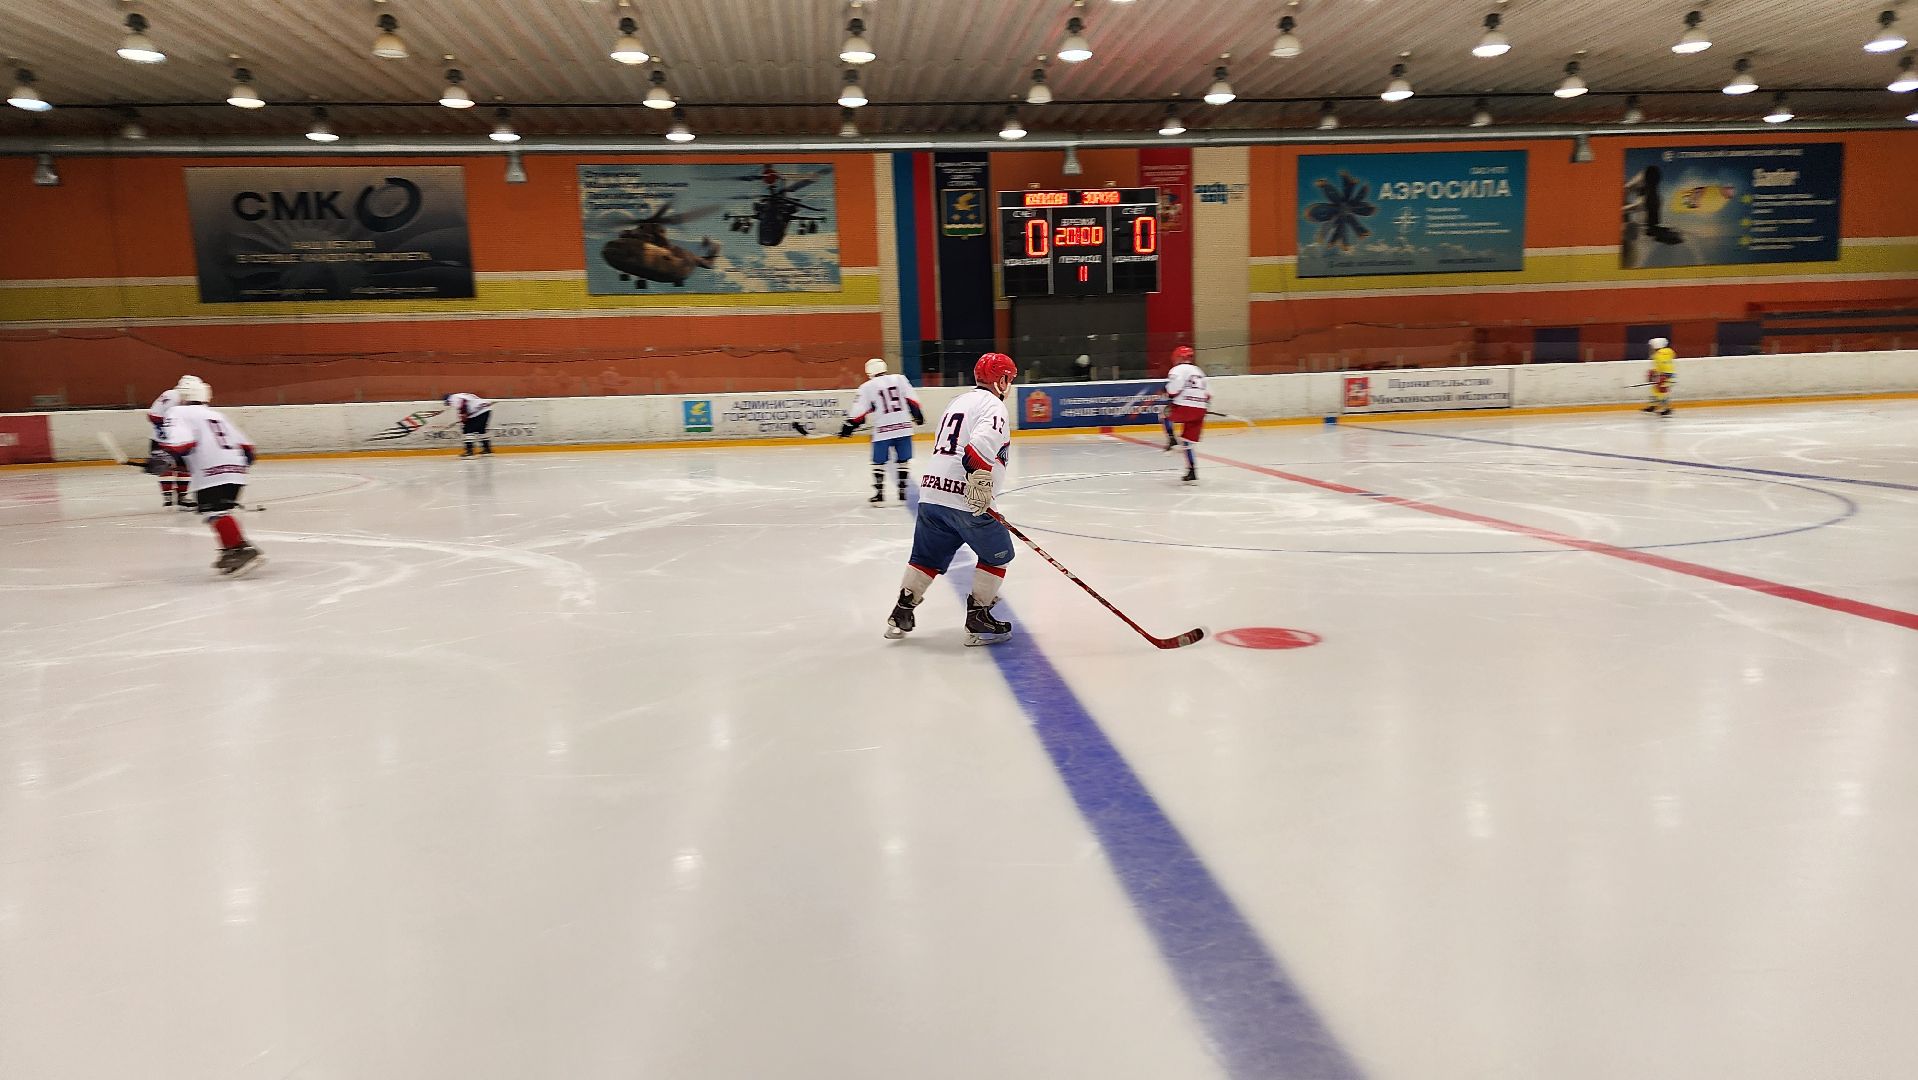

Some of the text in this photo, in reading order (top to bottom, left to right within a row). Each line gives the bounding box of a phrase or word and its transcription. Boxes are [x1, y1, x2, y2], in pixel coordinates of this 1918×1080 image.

[233, 191, 346, 221] СМК
[1379, 180, 1511, 200] АЭРОСИЛА
[1026, 219, 1049, 256] 0
[1055, 226, 1104, 246] 20:00
[1134, 216, 1157, 253] 0
[933, 413, 964, 455] 13
